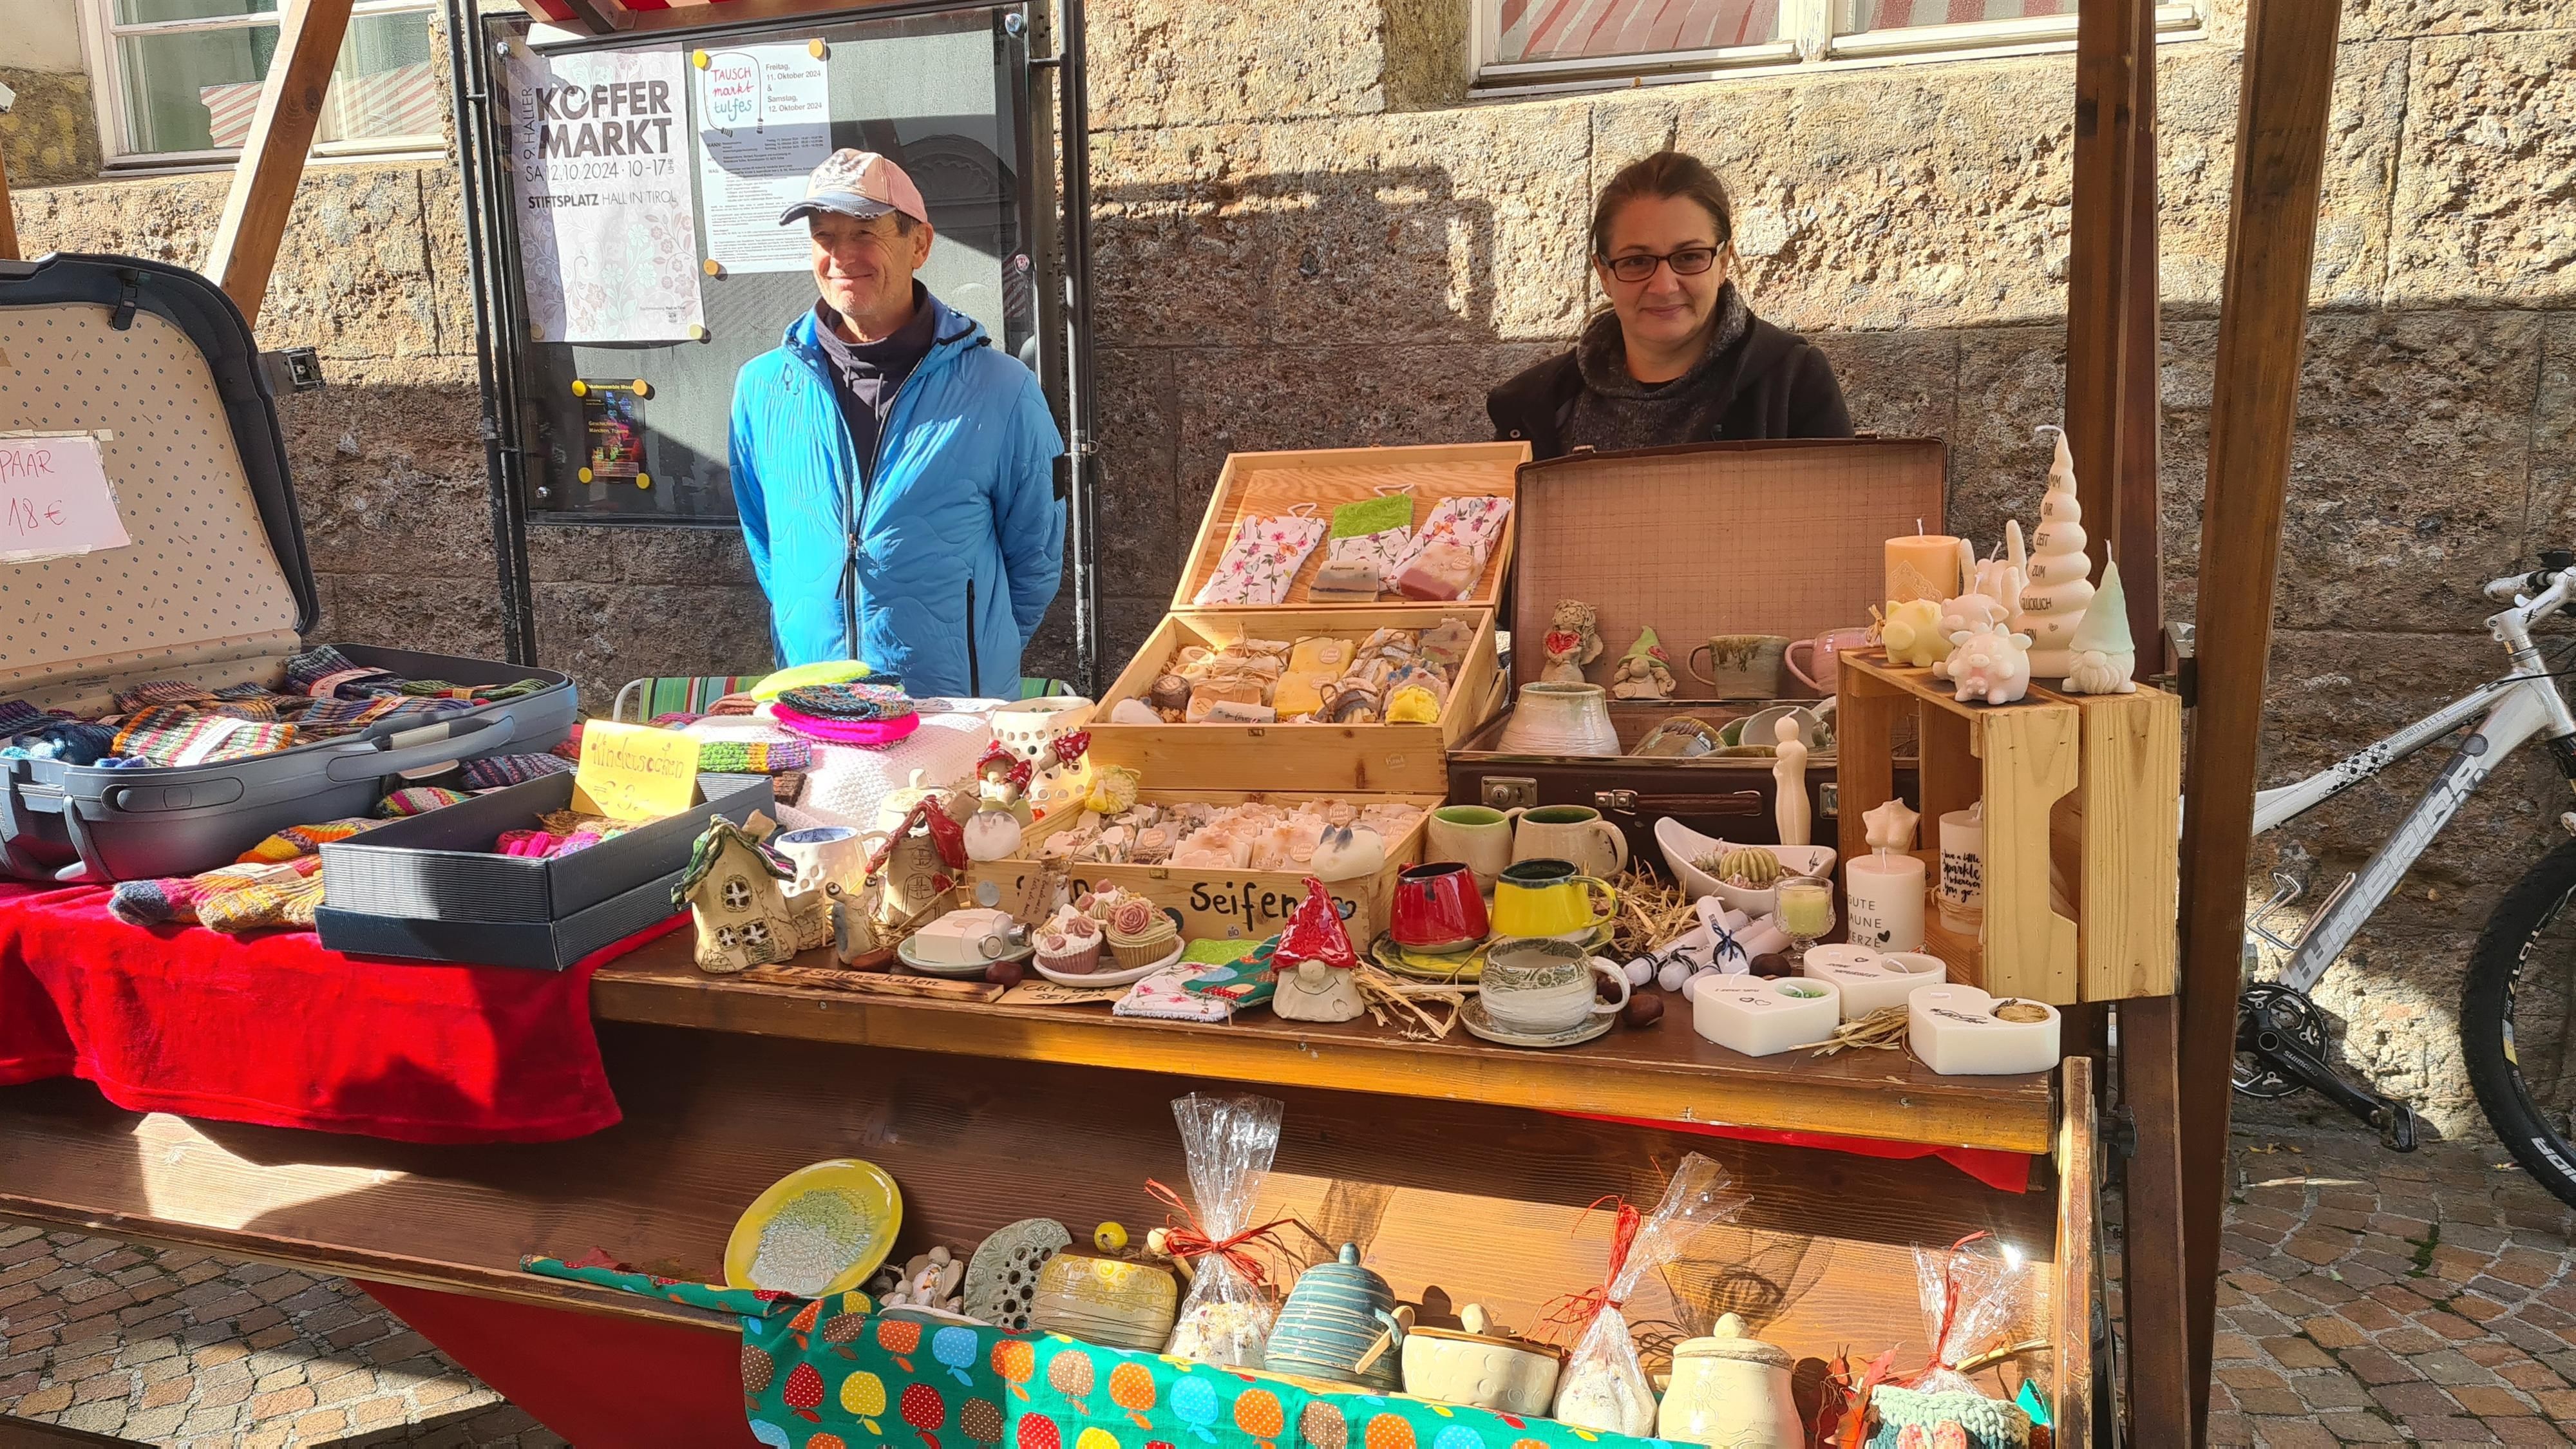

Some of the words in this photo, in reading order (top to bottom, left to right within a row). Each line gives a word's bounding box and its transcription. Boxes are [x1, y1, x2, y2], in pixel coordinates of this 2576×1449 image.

[711, 66, 752, 82] TAUSCH
[712, 80, 754, 97] markt
[536, 80, 672, 122] KOFFER
[714, 98, 752, 122] tulfes
[522, 88, 535, 143] HALLER
[538, 118, 672, 160] MARKT
[526, 166, 544, 182] SA
[528, 194, 599, 209] STIFTSPLATZ
[602, 192, 627, 205] HALL
[629, 192, 643, 204] IN
[647, 190, 677, 204] TIROL
[0, 450, 55, 483] PAAR
[9, 498, 39, 536] 18
[44, 500, 66, 526] €
[2036, 533, 2050, 547] ZEIT
[2032, 565, 2046, 578] ZUM
[2327, 755, 2490, 953] MERIDA
[1190, 882, 1298, 932] Seifen
[810, 968, 944, 987] Seifenschalen
[1030, 992, 1106, 1002] SEIFEN
[2283, 1050, 2318, 1076] SHIMANO
